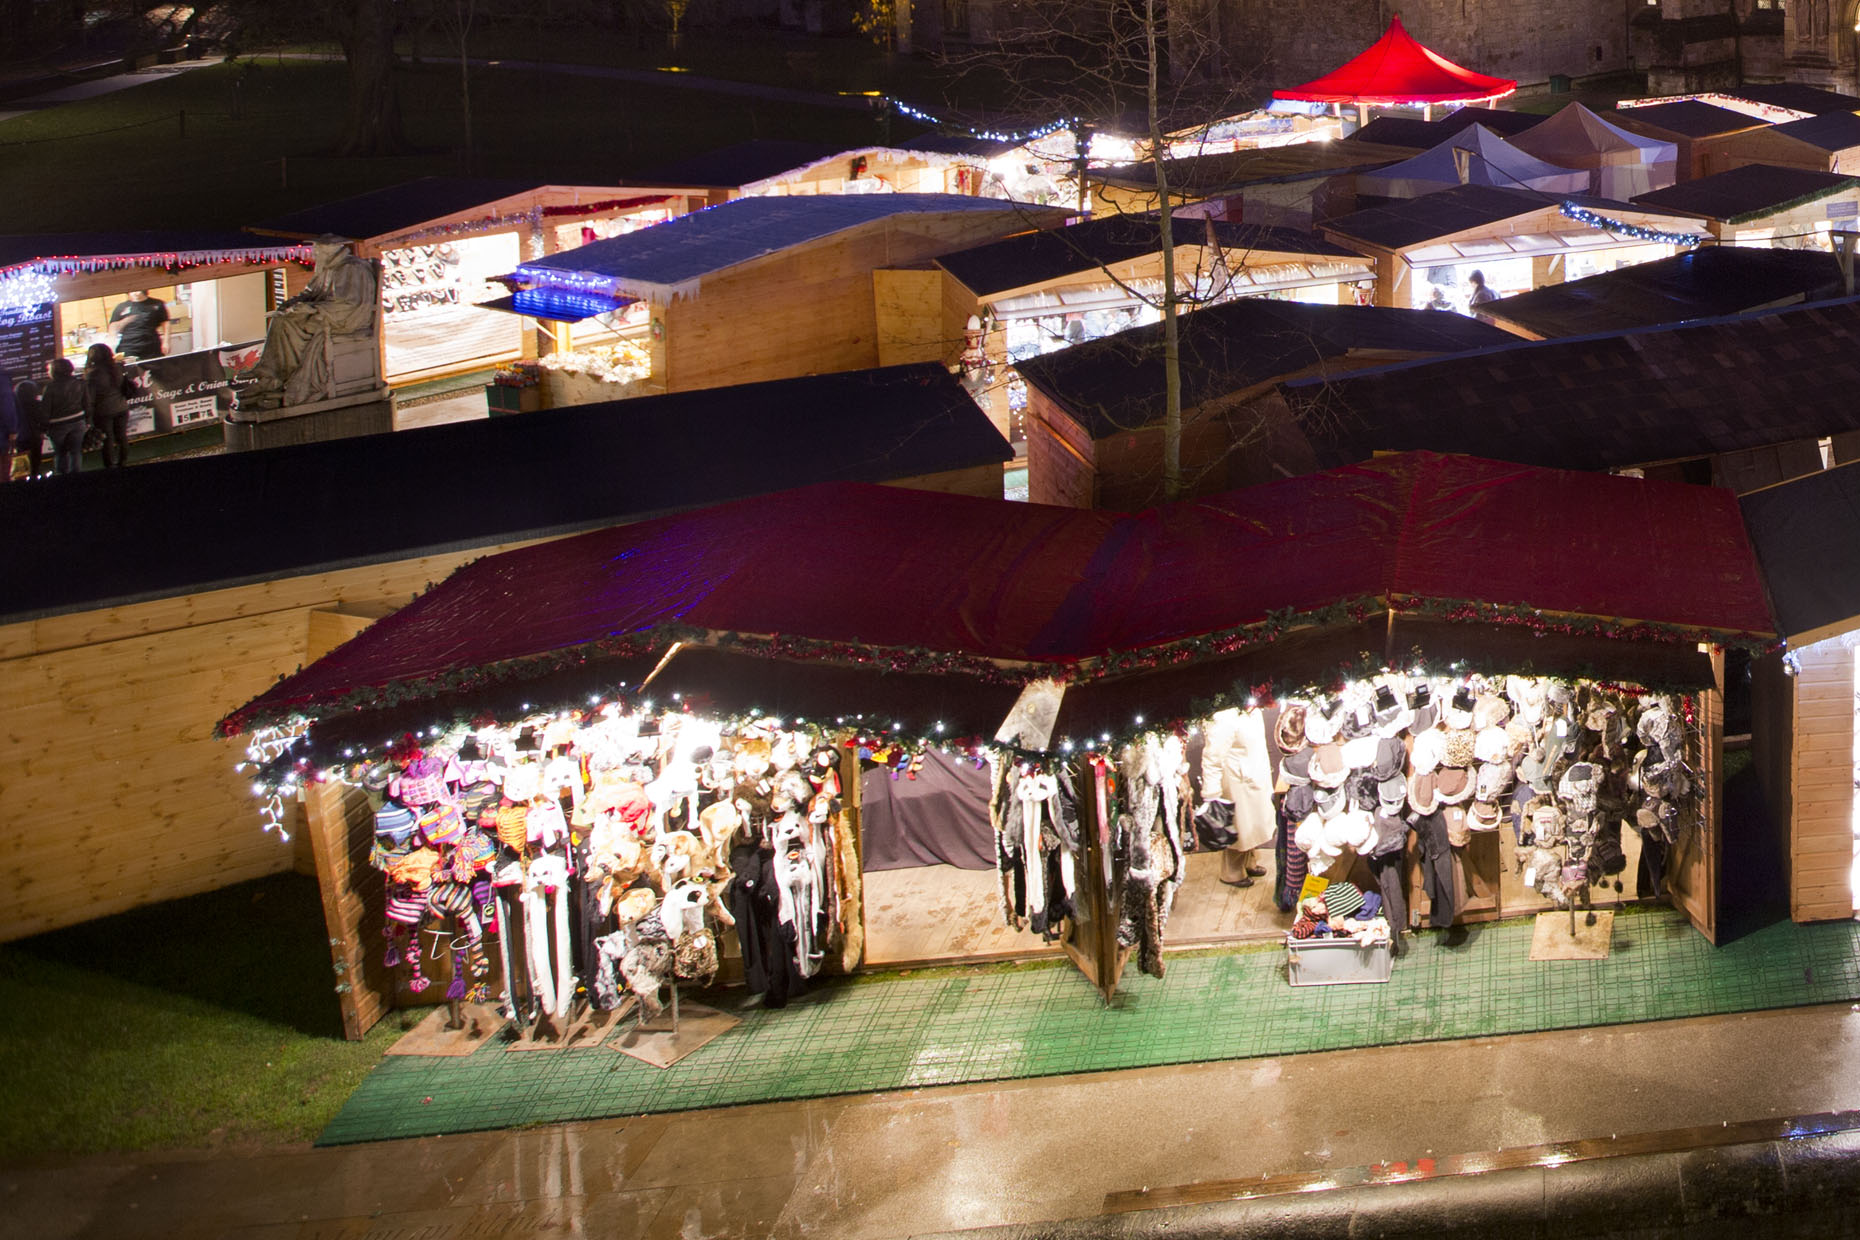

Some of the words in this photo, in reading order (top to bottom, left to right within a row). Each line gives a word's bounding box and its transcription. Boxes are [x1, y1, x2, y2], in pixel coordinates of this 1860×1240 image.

[156, 389, 183, 401] Sage
[185, 383, 196, 394] &
[198, 379, 229, 392] Onion
